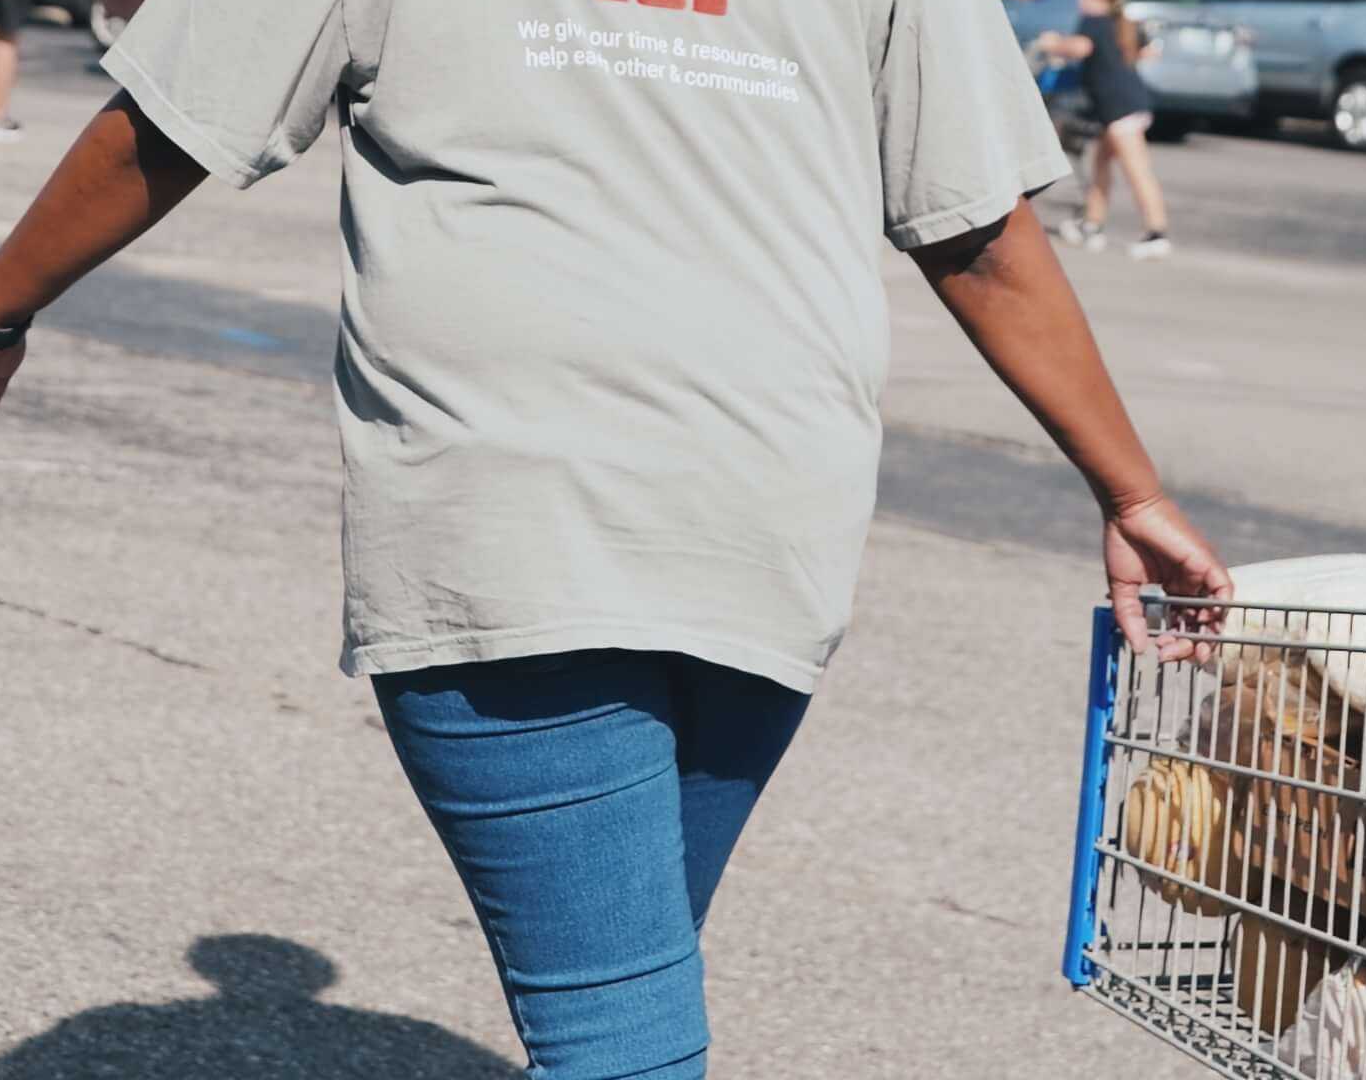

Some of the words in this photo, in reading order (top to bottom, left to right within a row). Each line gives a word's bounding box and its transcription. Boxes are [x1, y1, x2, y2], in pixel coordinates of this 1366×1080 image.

[517, 20, 550, 40] We
[589, 29, 624, 49] our
[627, 30, 669, 54] time
[672, 37, 687, 58] &
[691, 43, 777, 71] resources
[524, 45, 568, 70] help
[614, 56, 667, 79] other
[684, 70, 800, 103] communities
